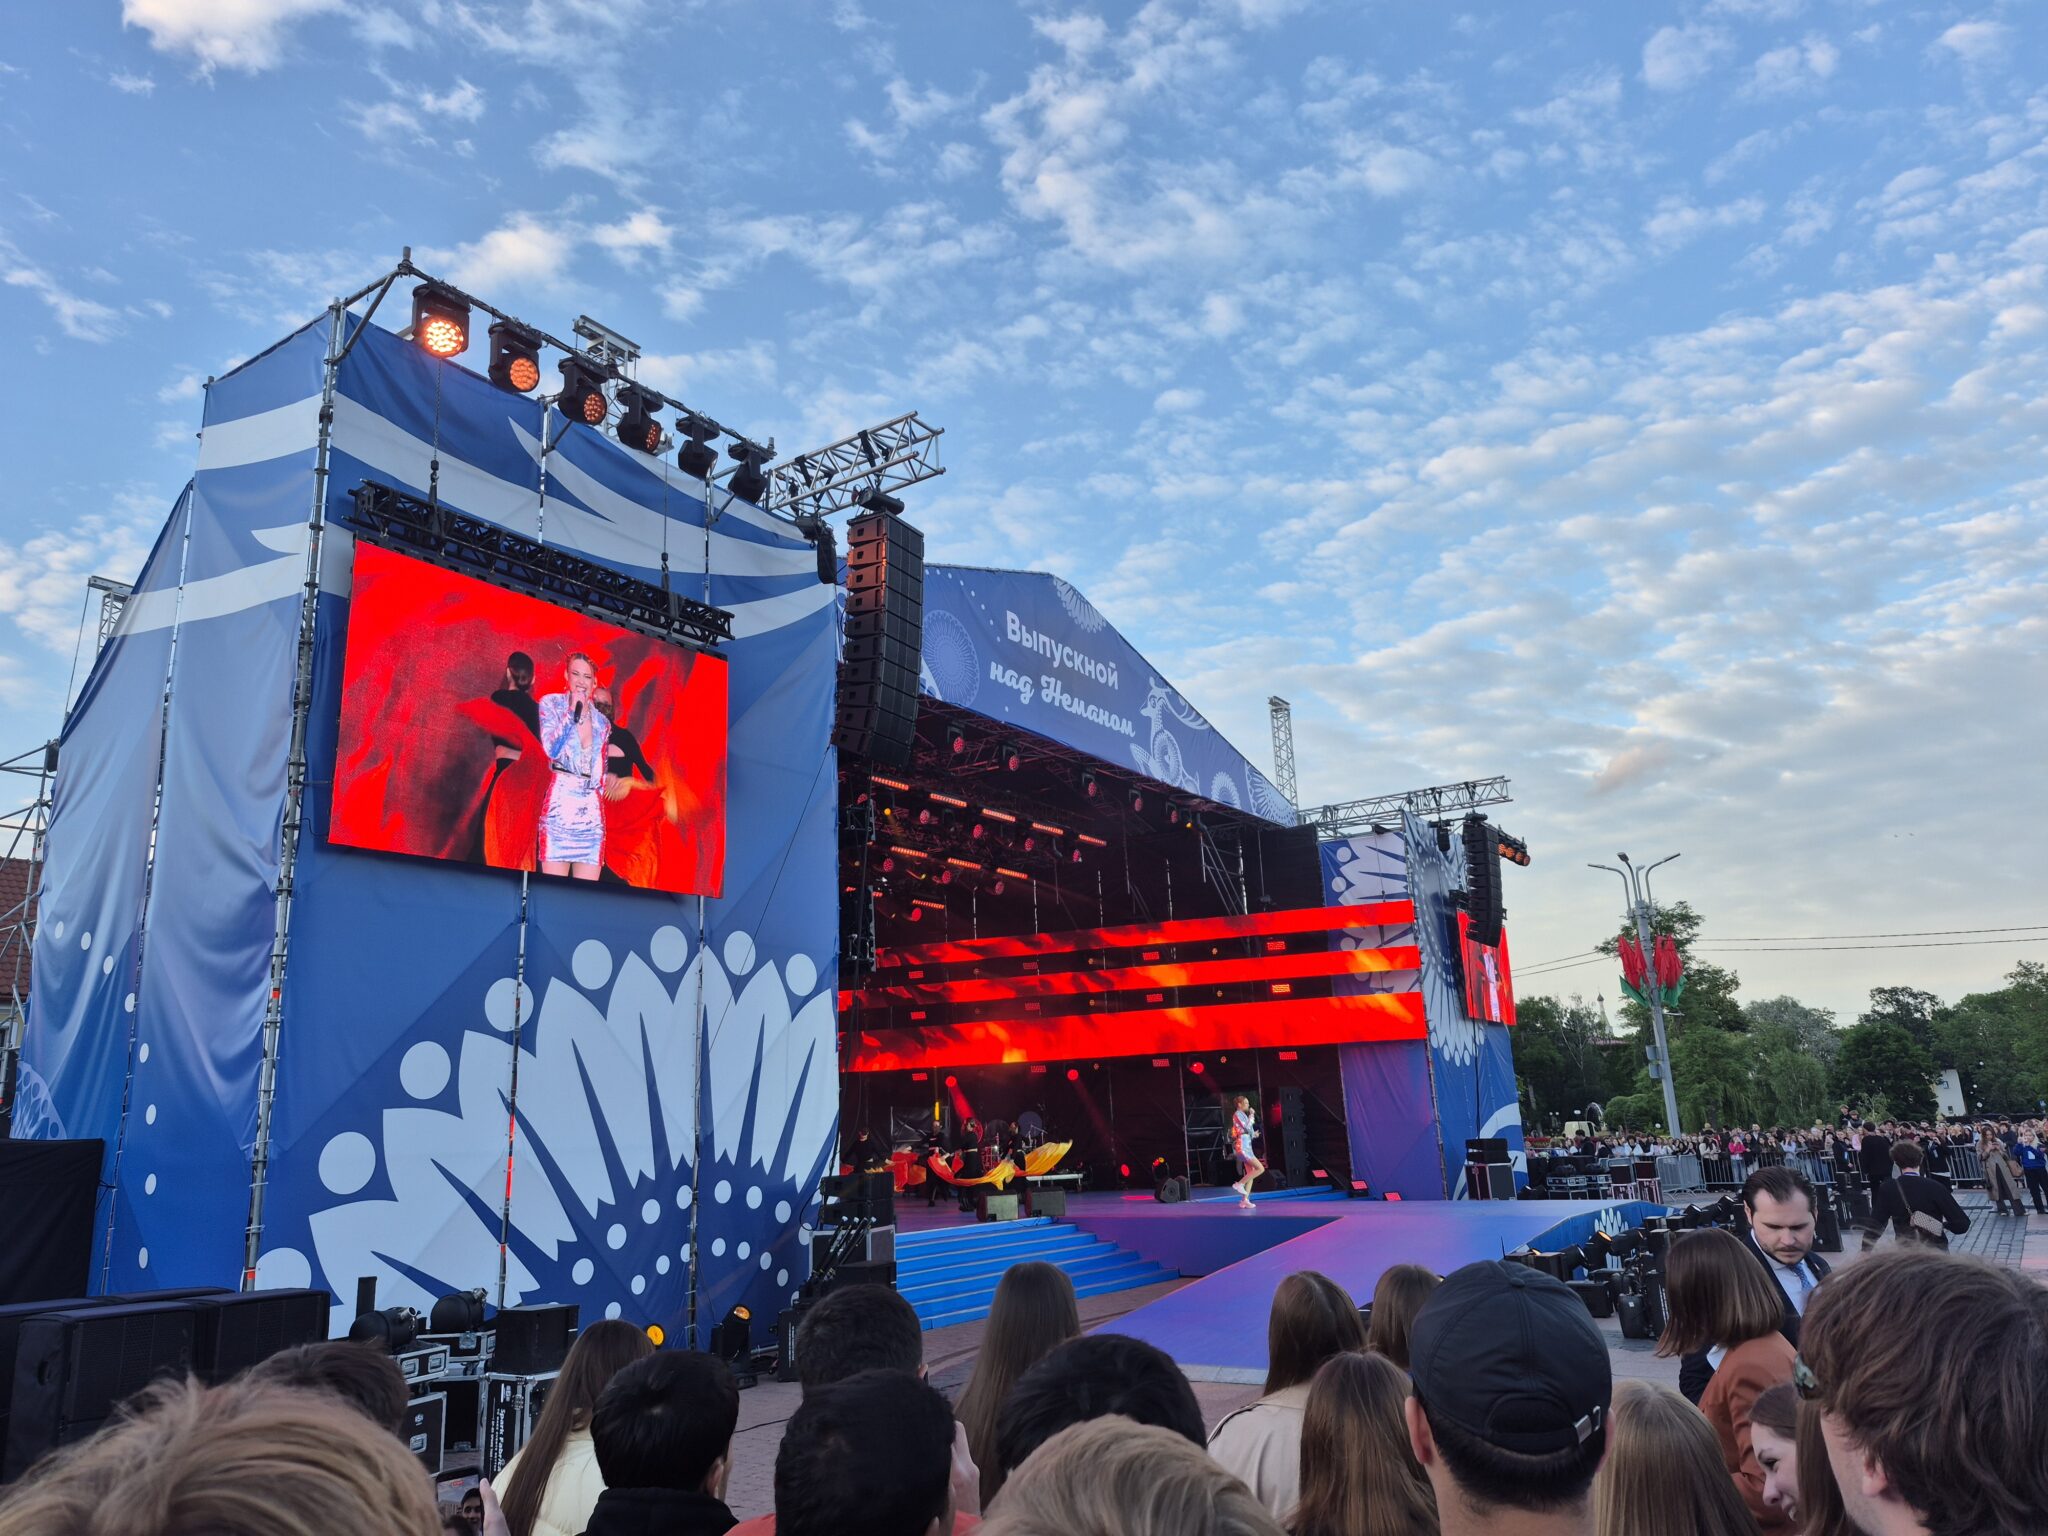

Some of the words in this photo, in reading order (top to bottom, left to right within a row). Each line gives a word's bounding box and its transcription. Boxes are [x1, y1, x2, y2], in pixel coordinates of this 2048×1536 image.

[1006, 610, 1119, 690] Выпускной
[990, 661, 1035, 705] над
[1040, 674, 1136, 738] Неманом
